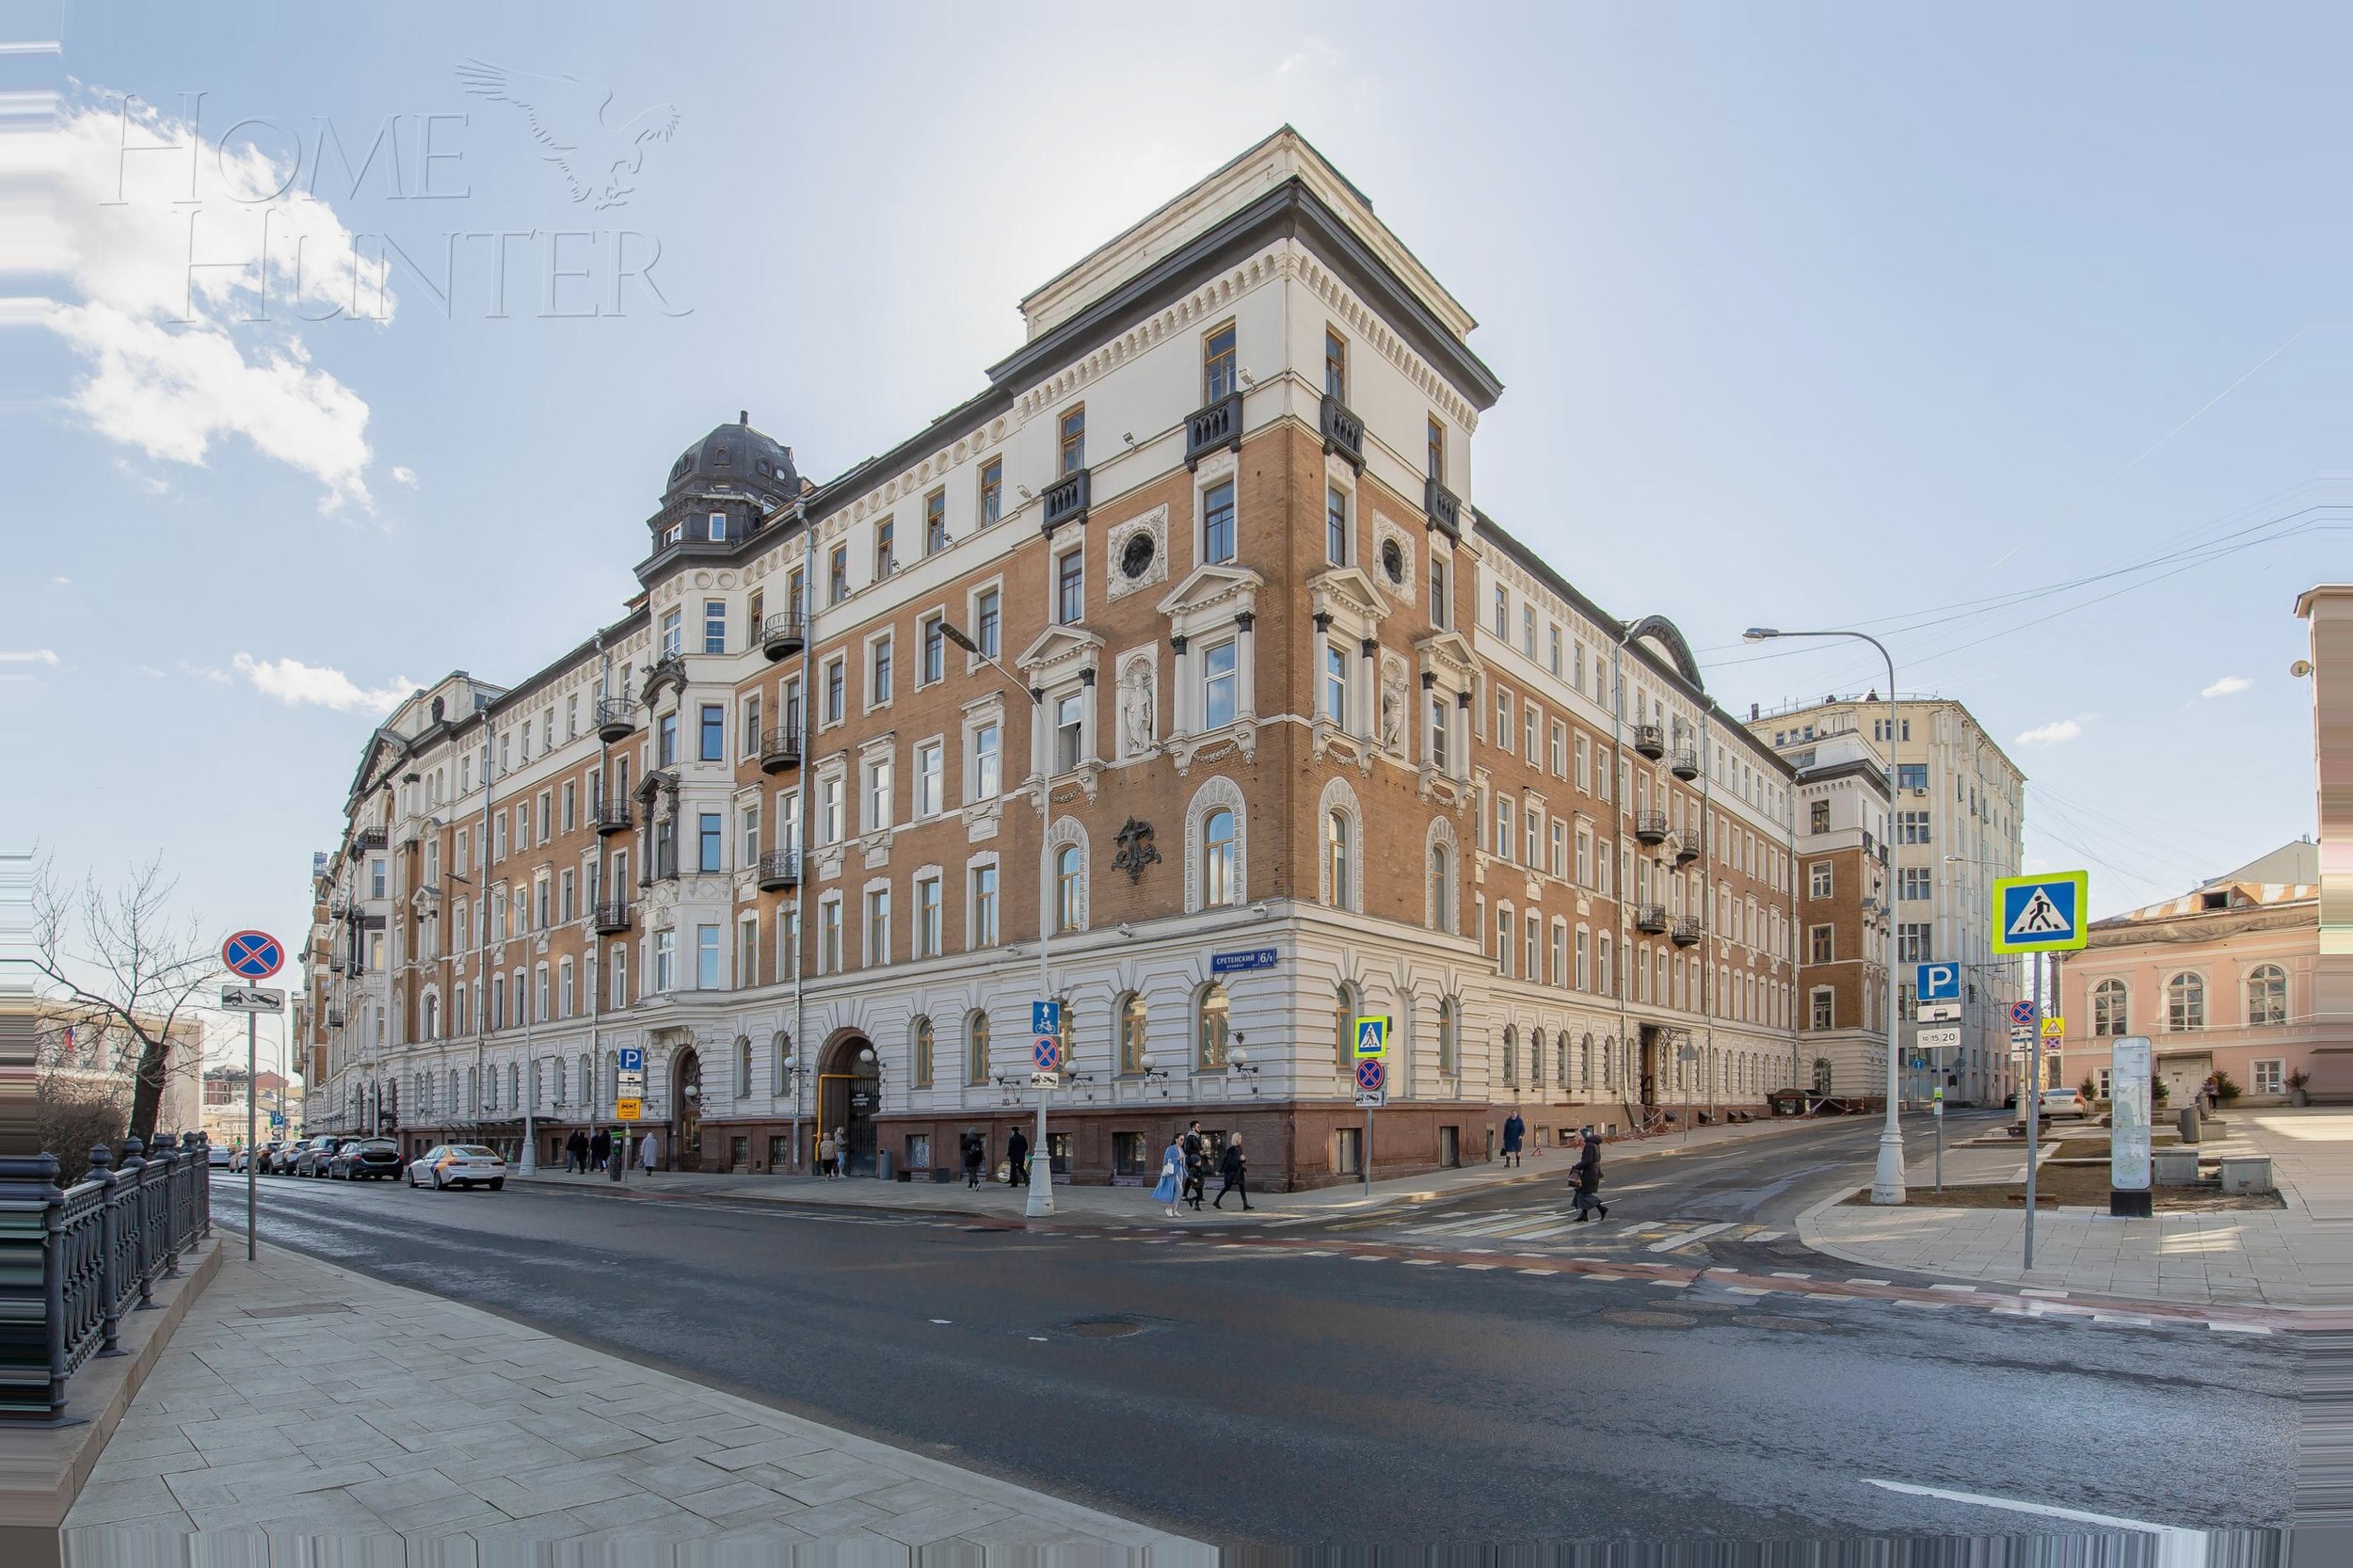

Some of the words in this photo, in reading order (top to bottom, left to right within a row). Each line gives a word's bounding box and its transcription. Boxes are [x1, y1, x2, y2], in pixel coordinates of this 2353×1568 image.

[1216, 953, 1256, 965] СРЕТЕНСКИЙ
[1259, 952, 1273, 963] 6/1
[1929, 967, 1952, 996] P
[1942, 1032, 1956, 1042] 20
[626, 1050, 638, 1067] P
